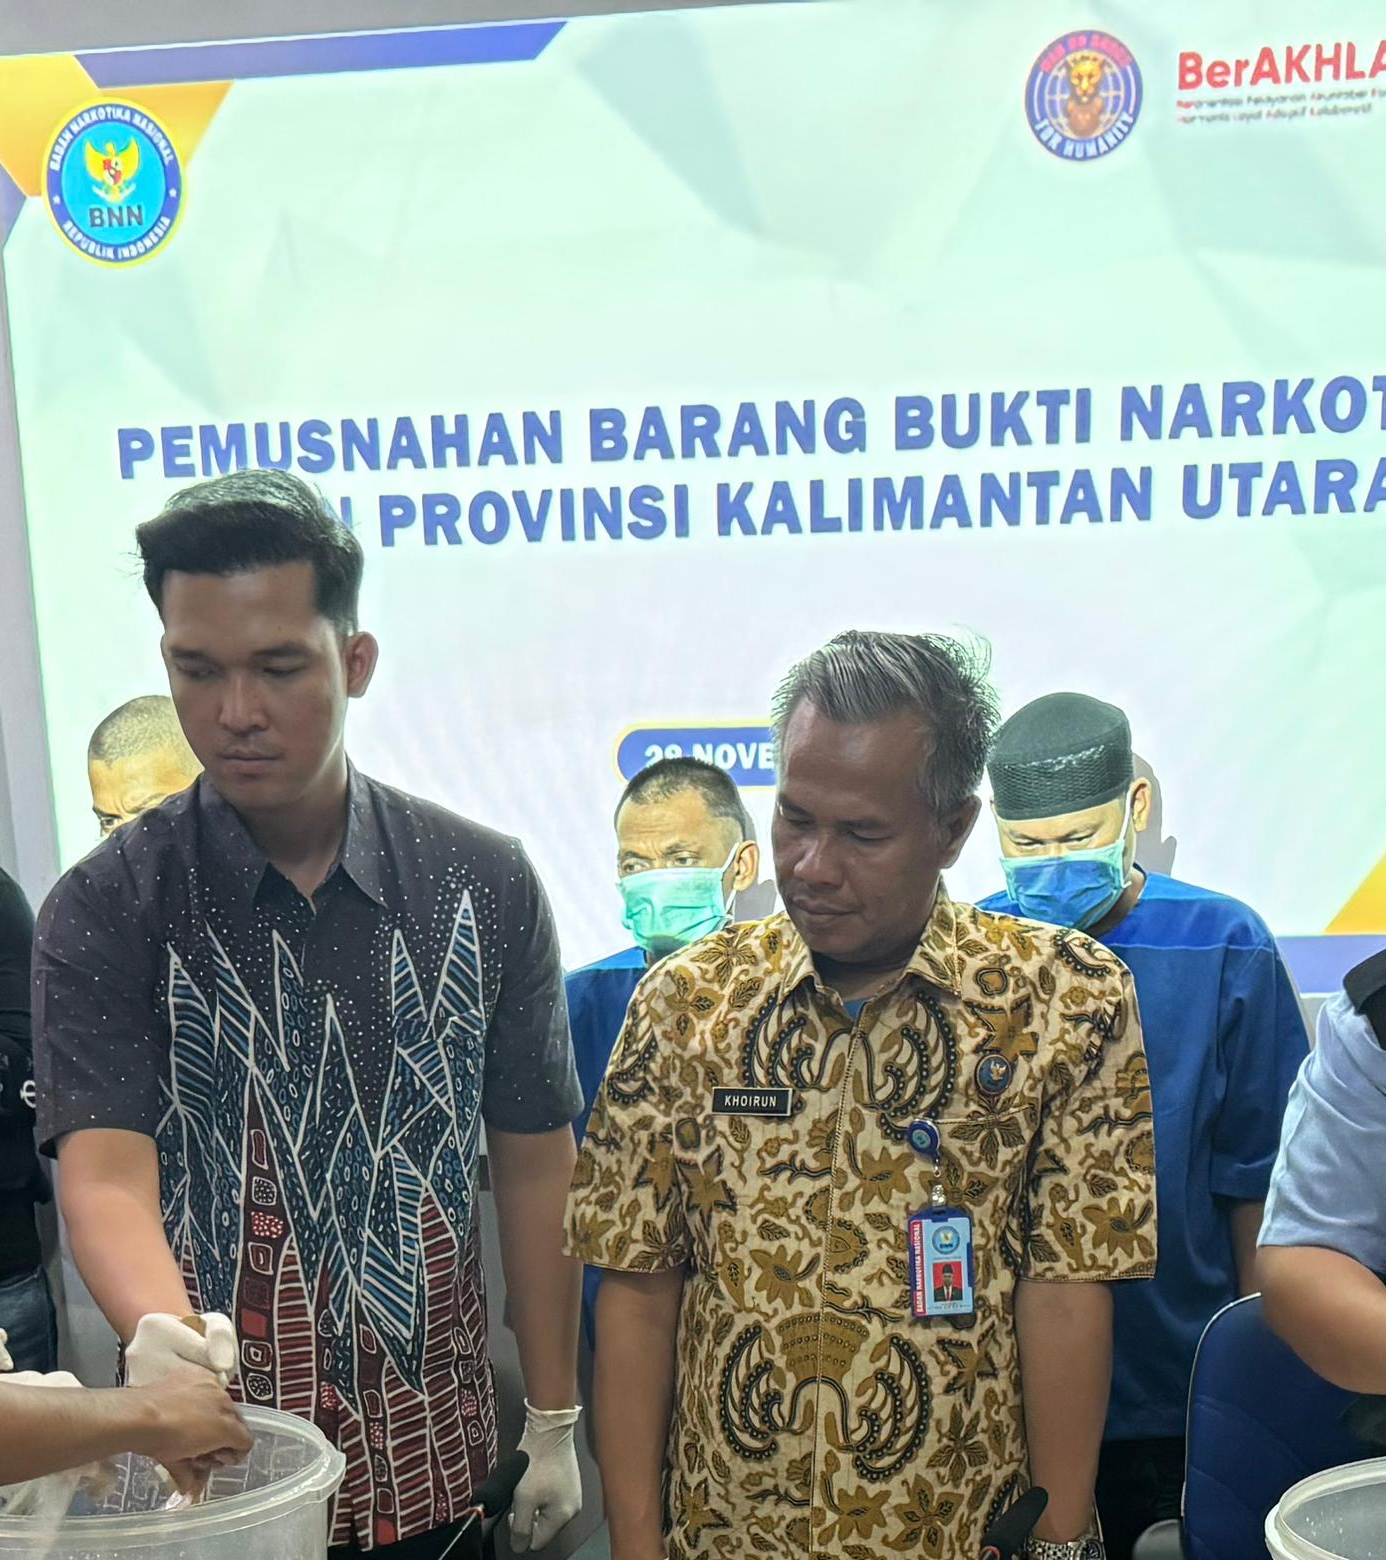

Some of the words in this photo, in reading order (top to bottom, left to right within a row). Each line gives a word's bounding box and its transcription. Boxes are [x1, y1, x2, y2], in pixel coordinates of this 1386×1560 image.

[69, 106, 131, 135] NARKOTIKA
[88, 205, 144, 228] BNN
[117, 410, 563, 480] PEMUSNAHAN
[589, 398, 866, 464] BARANG
[894, 388, 1092, 452] BUKTI
[379, 484, 689, 547] PROVINSI
[717, 466, 1153, 536] KALIMANTAN
[724, 1095, 777, 1107] KHOIRUN
